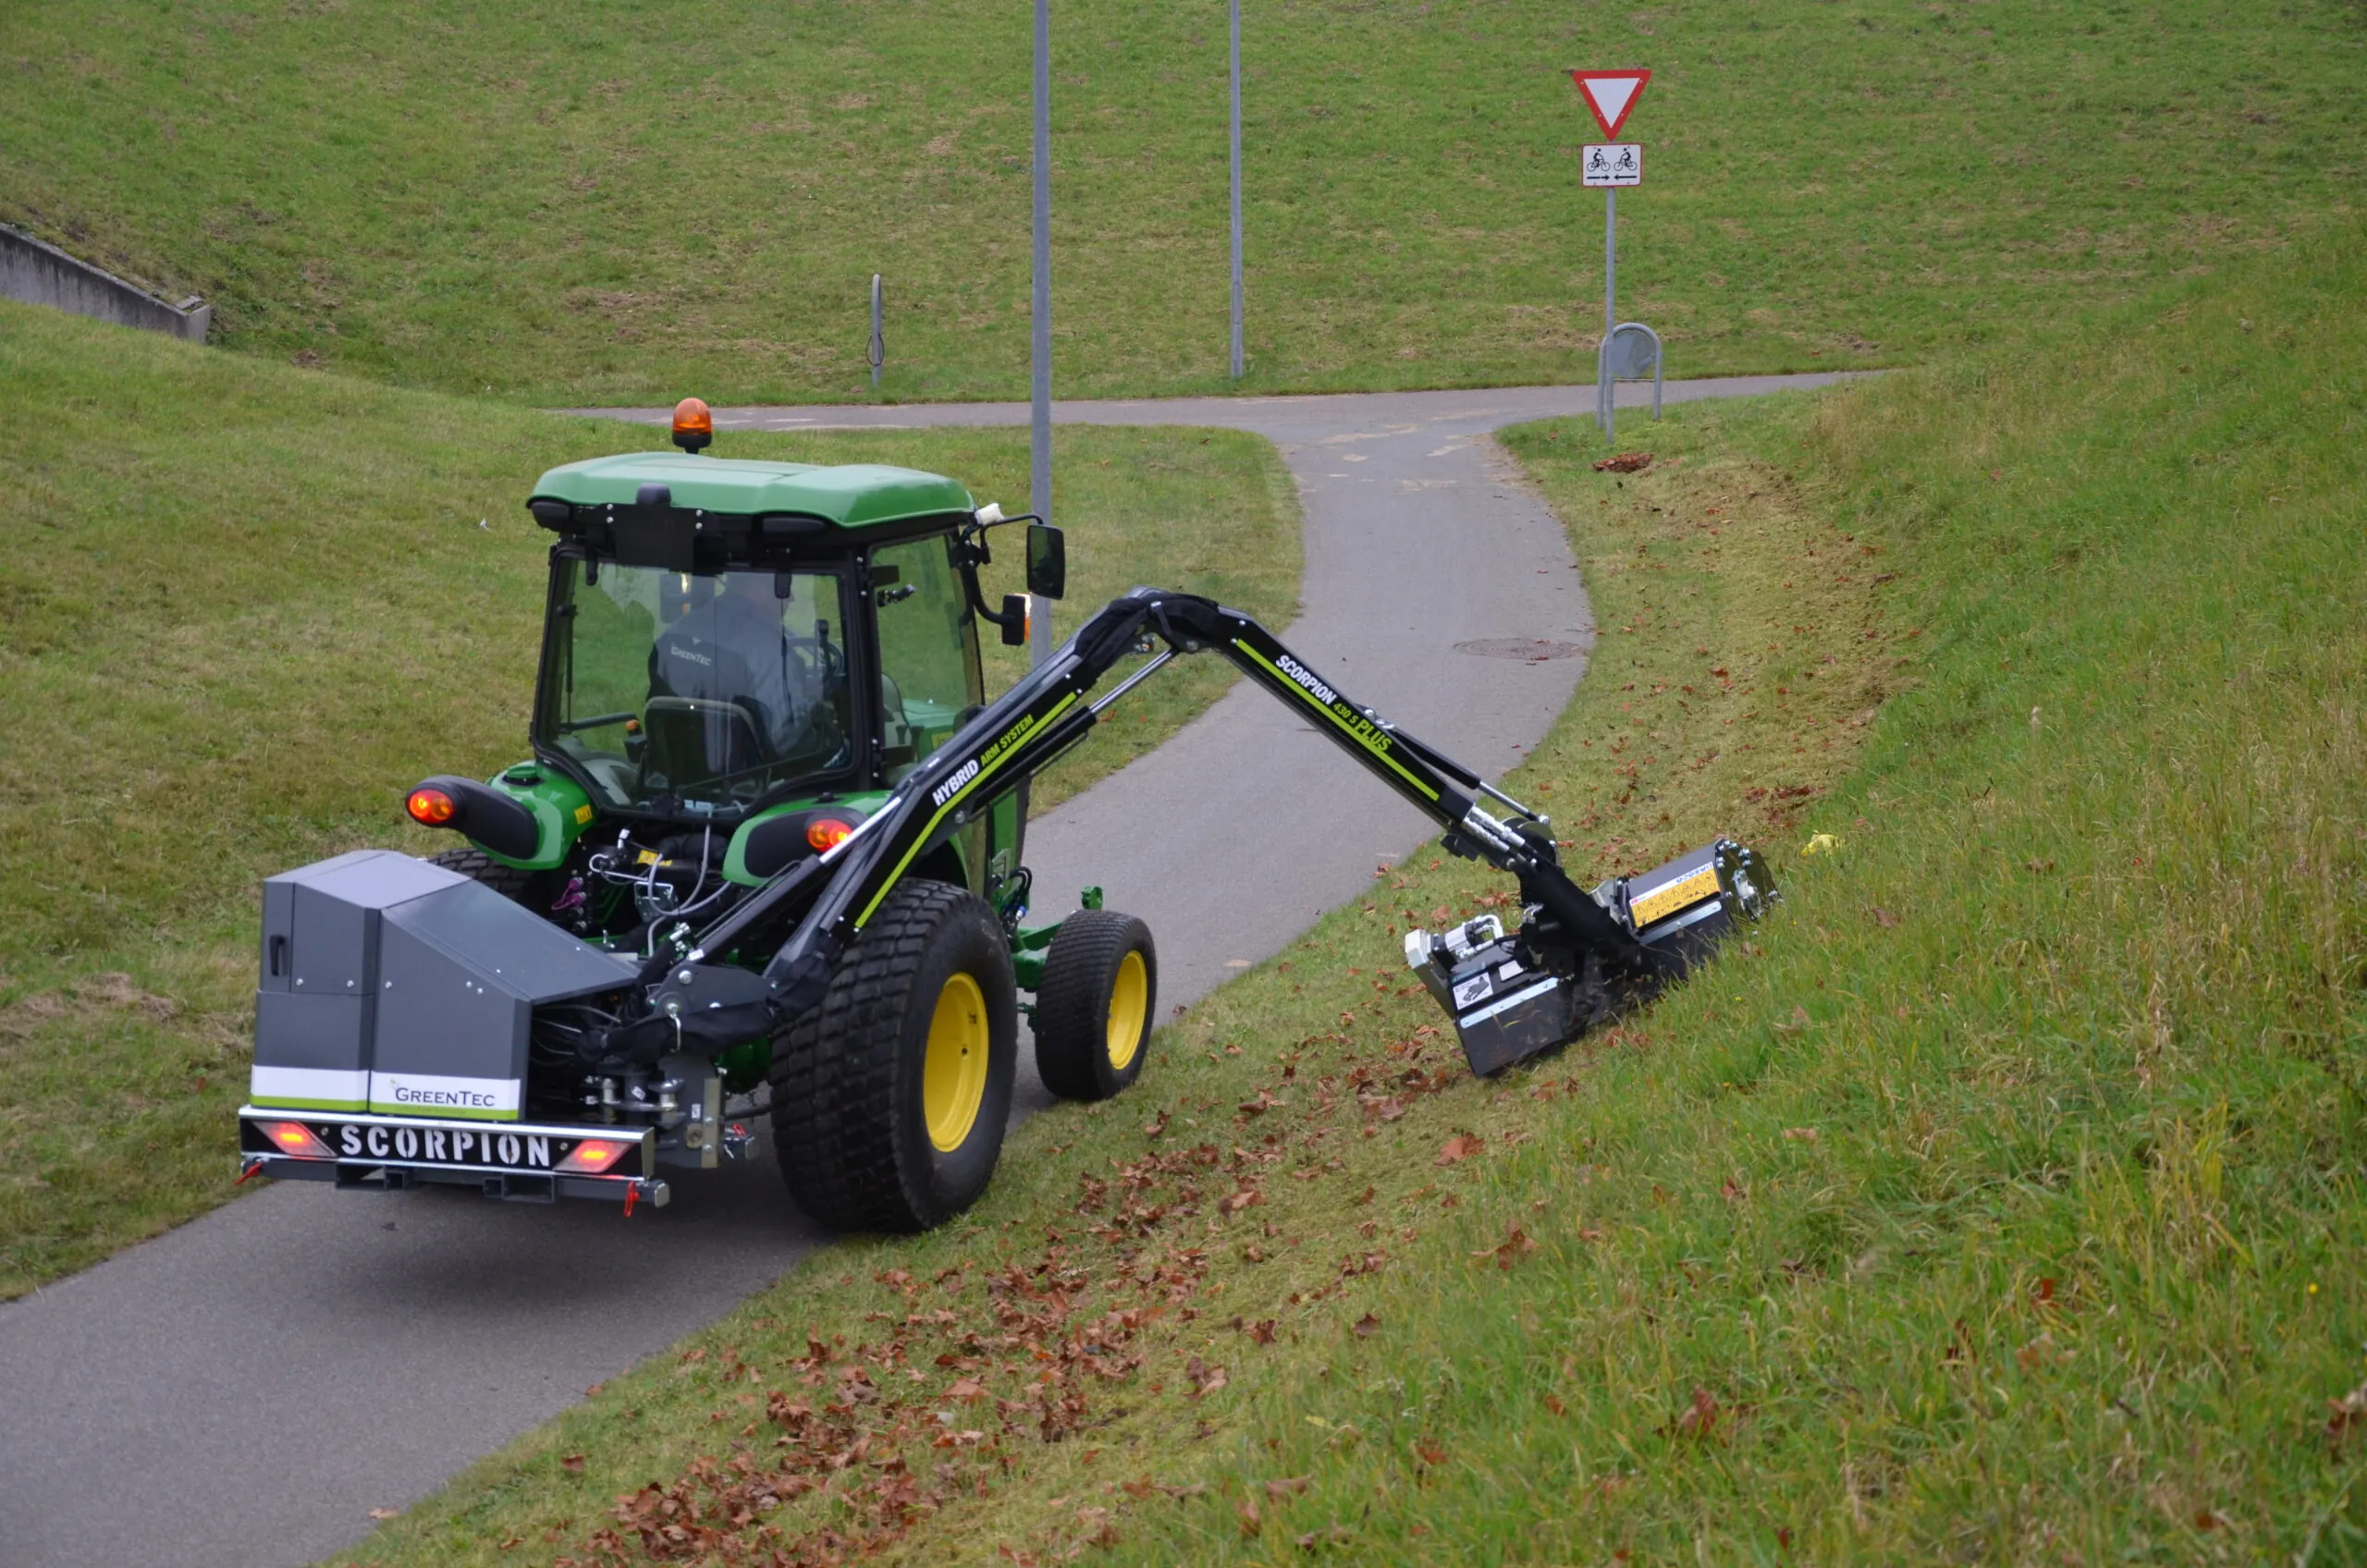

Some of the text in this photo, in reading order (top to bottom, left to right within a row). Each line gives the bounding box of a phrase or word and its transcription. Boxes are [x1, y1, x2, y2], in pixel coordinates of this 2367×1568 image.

[1276, 655, 1337, 705] SCORPION
[1333, 704, 1352, 718] 430
[1354, 719, 1392, 751] PLUS
[932, 714, 1034, 806] HYBRID ARM SYSTEM
[340, 1124, 550, 1166] SCORPION
